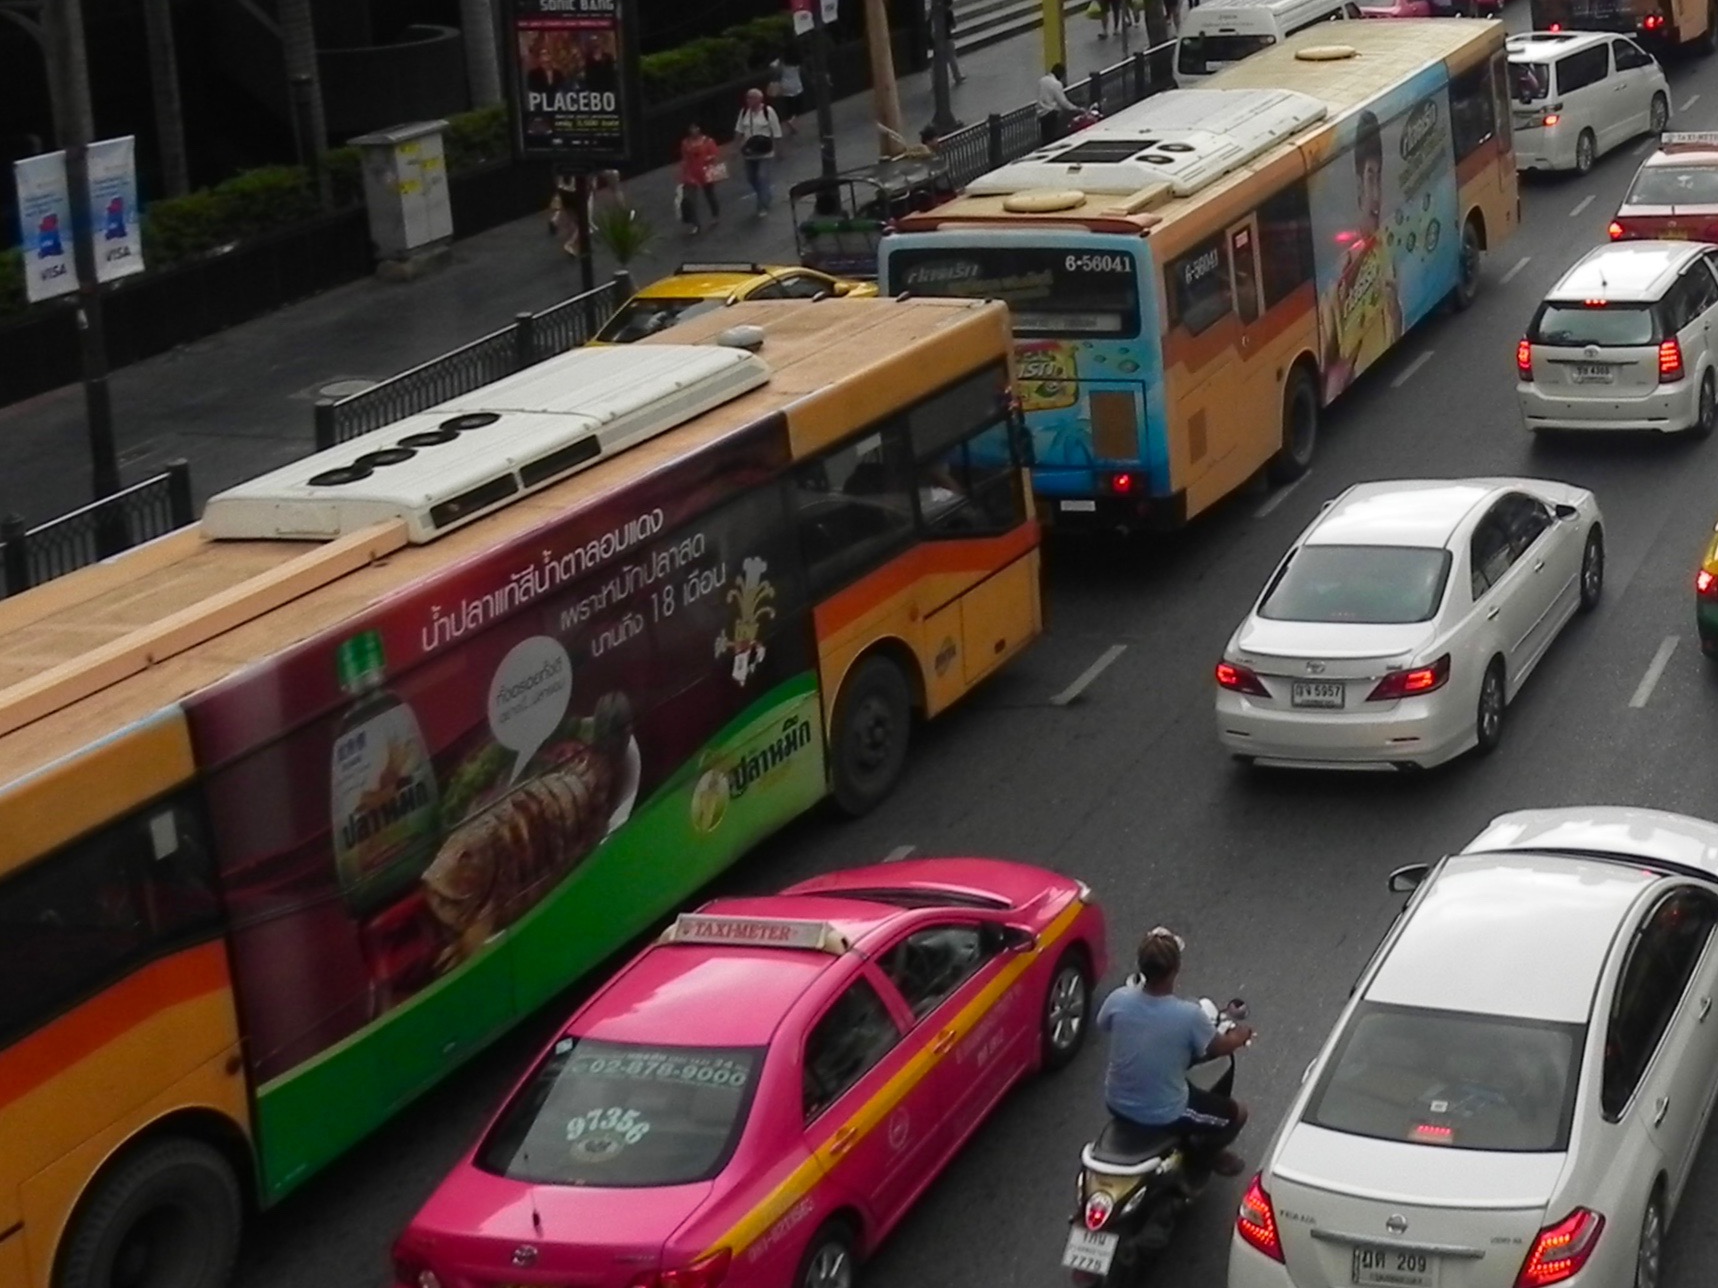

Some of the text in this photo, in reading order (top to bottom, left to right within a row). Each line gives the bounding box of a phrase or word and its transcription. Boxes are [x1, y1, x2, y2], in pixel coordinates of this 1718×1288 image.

[528, 92, 615, 112] PLACEBO
[106, 246, 131, 262] VISA
[41, 263, 67, 281] VISA
[591, 562, 726, 656] นานถึง 18 เดือน
[590, 1060, 747, 1089] 02-878-9000
[566, 1106, 651, 1145] 97356
[1397, 1254, 1427, 1273] 209
